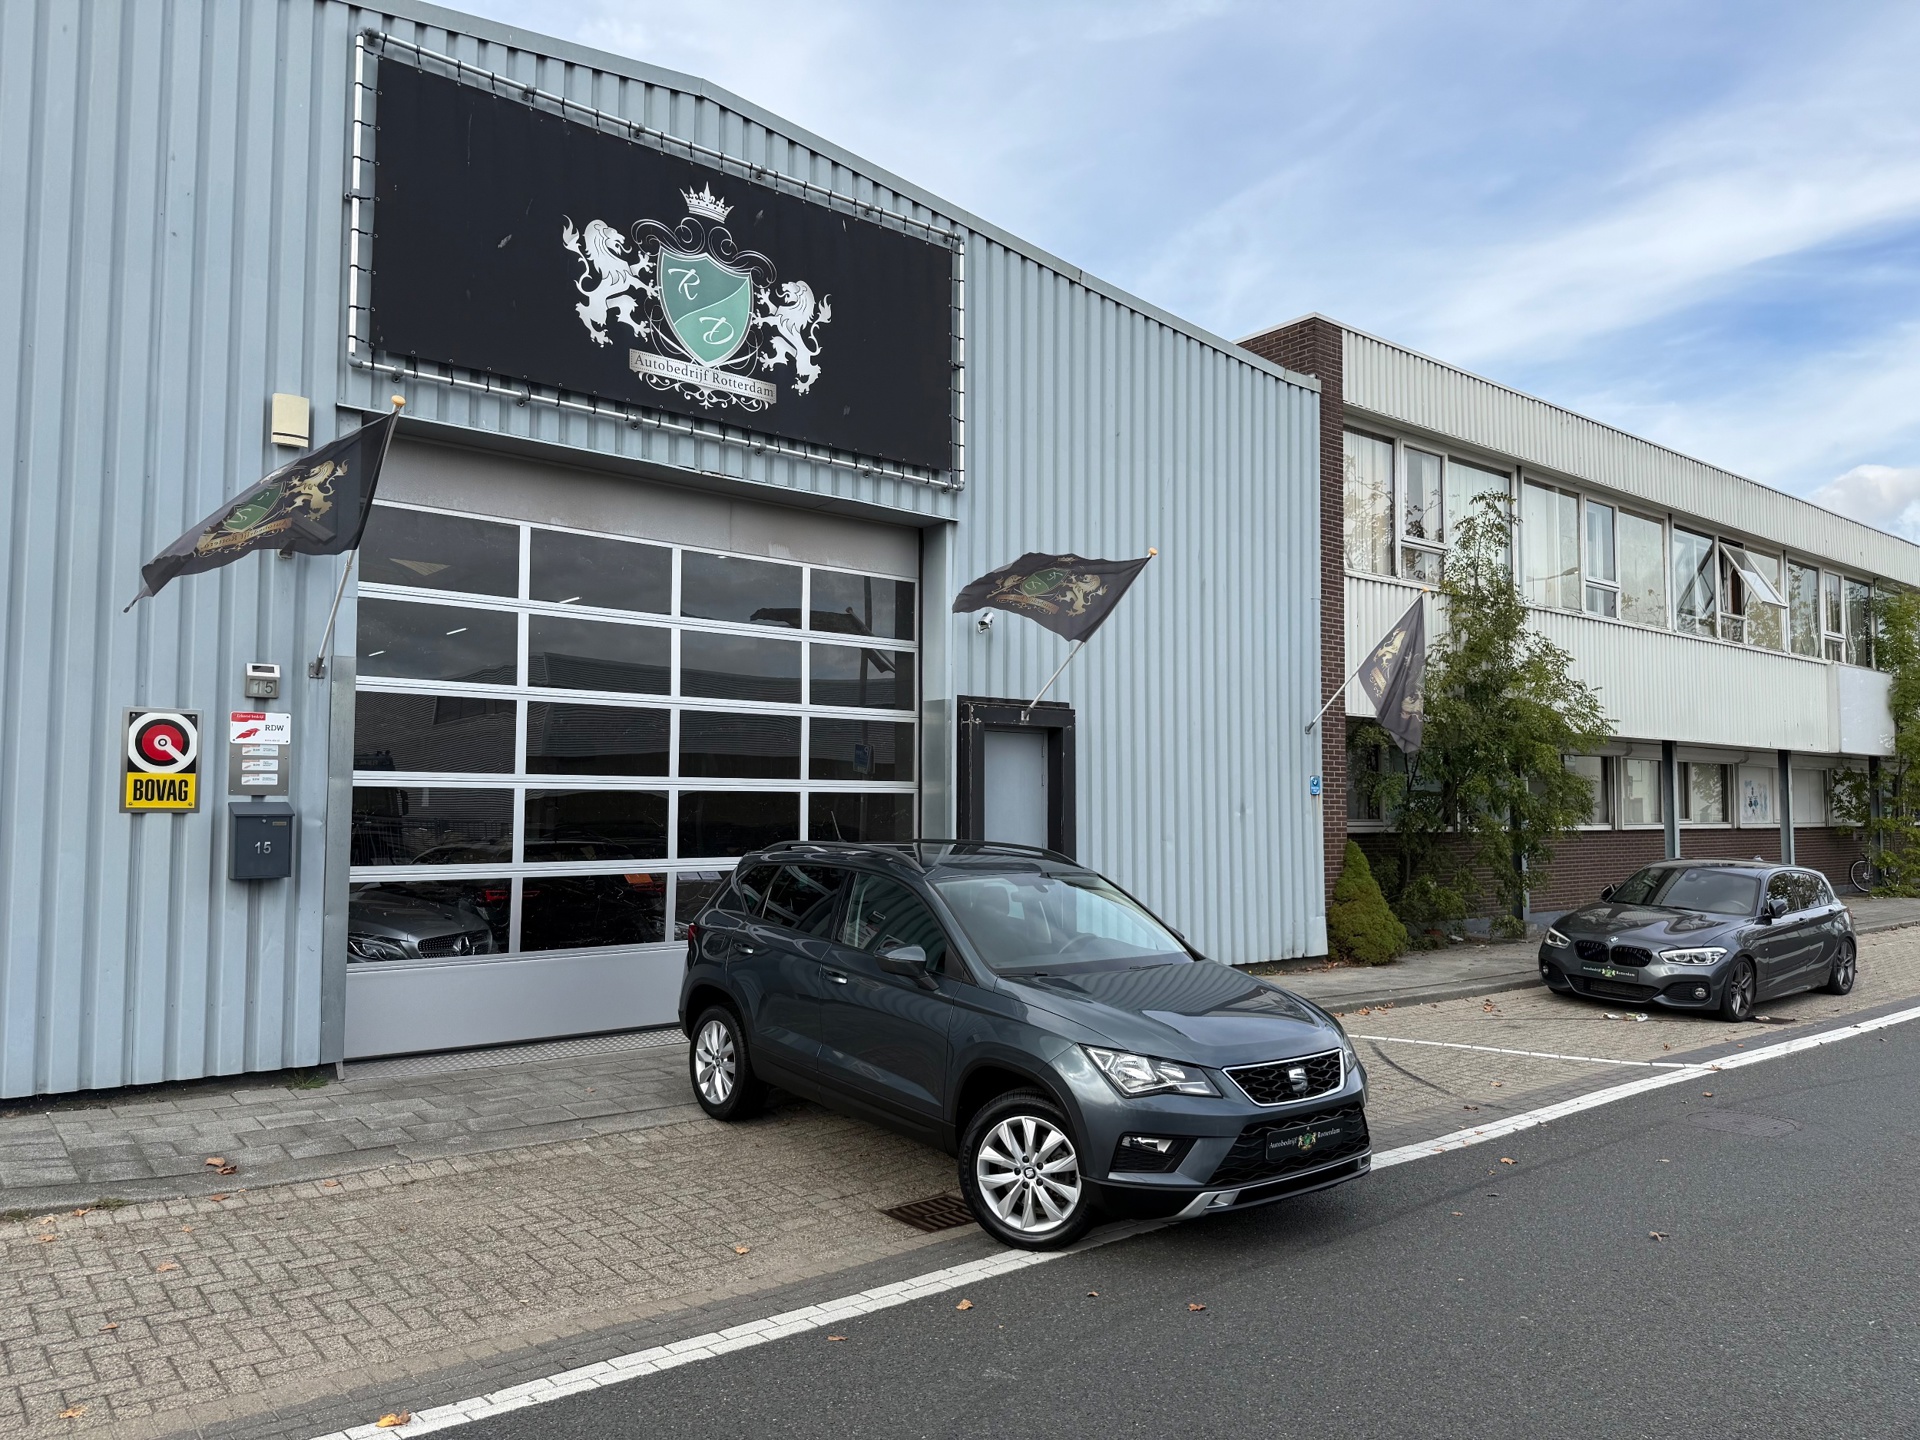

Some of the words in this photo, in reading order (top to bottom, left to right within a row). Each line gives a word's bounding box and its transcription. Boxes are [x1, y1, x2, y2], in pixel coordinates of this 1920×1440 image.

[635, 354, 709, 381] Autobedrijf
[712, 372, 774, 397] Rotterdam
[254, 681, 273, 694] 15
[132, 778, 189, 802] BOVAG
[254, 841, 272, 854] 15
